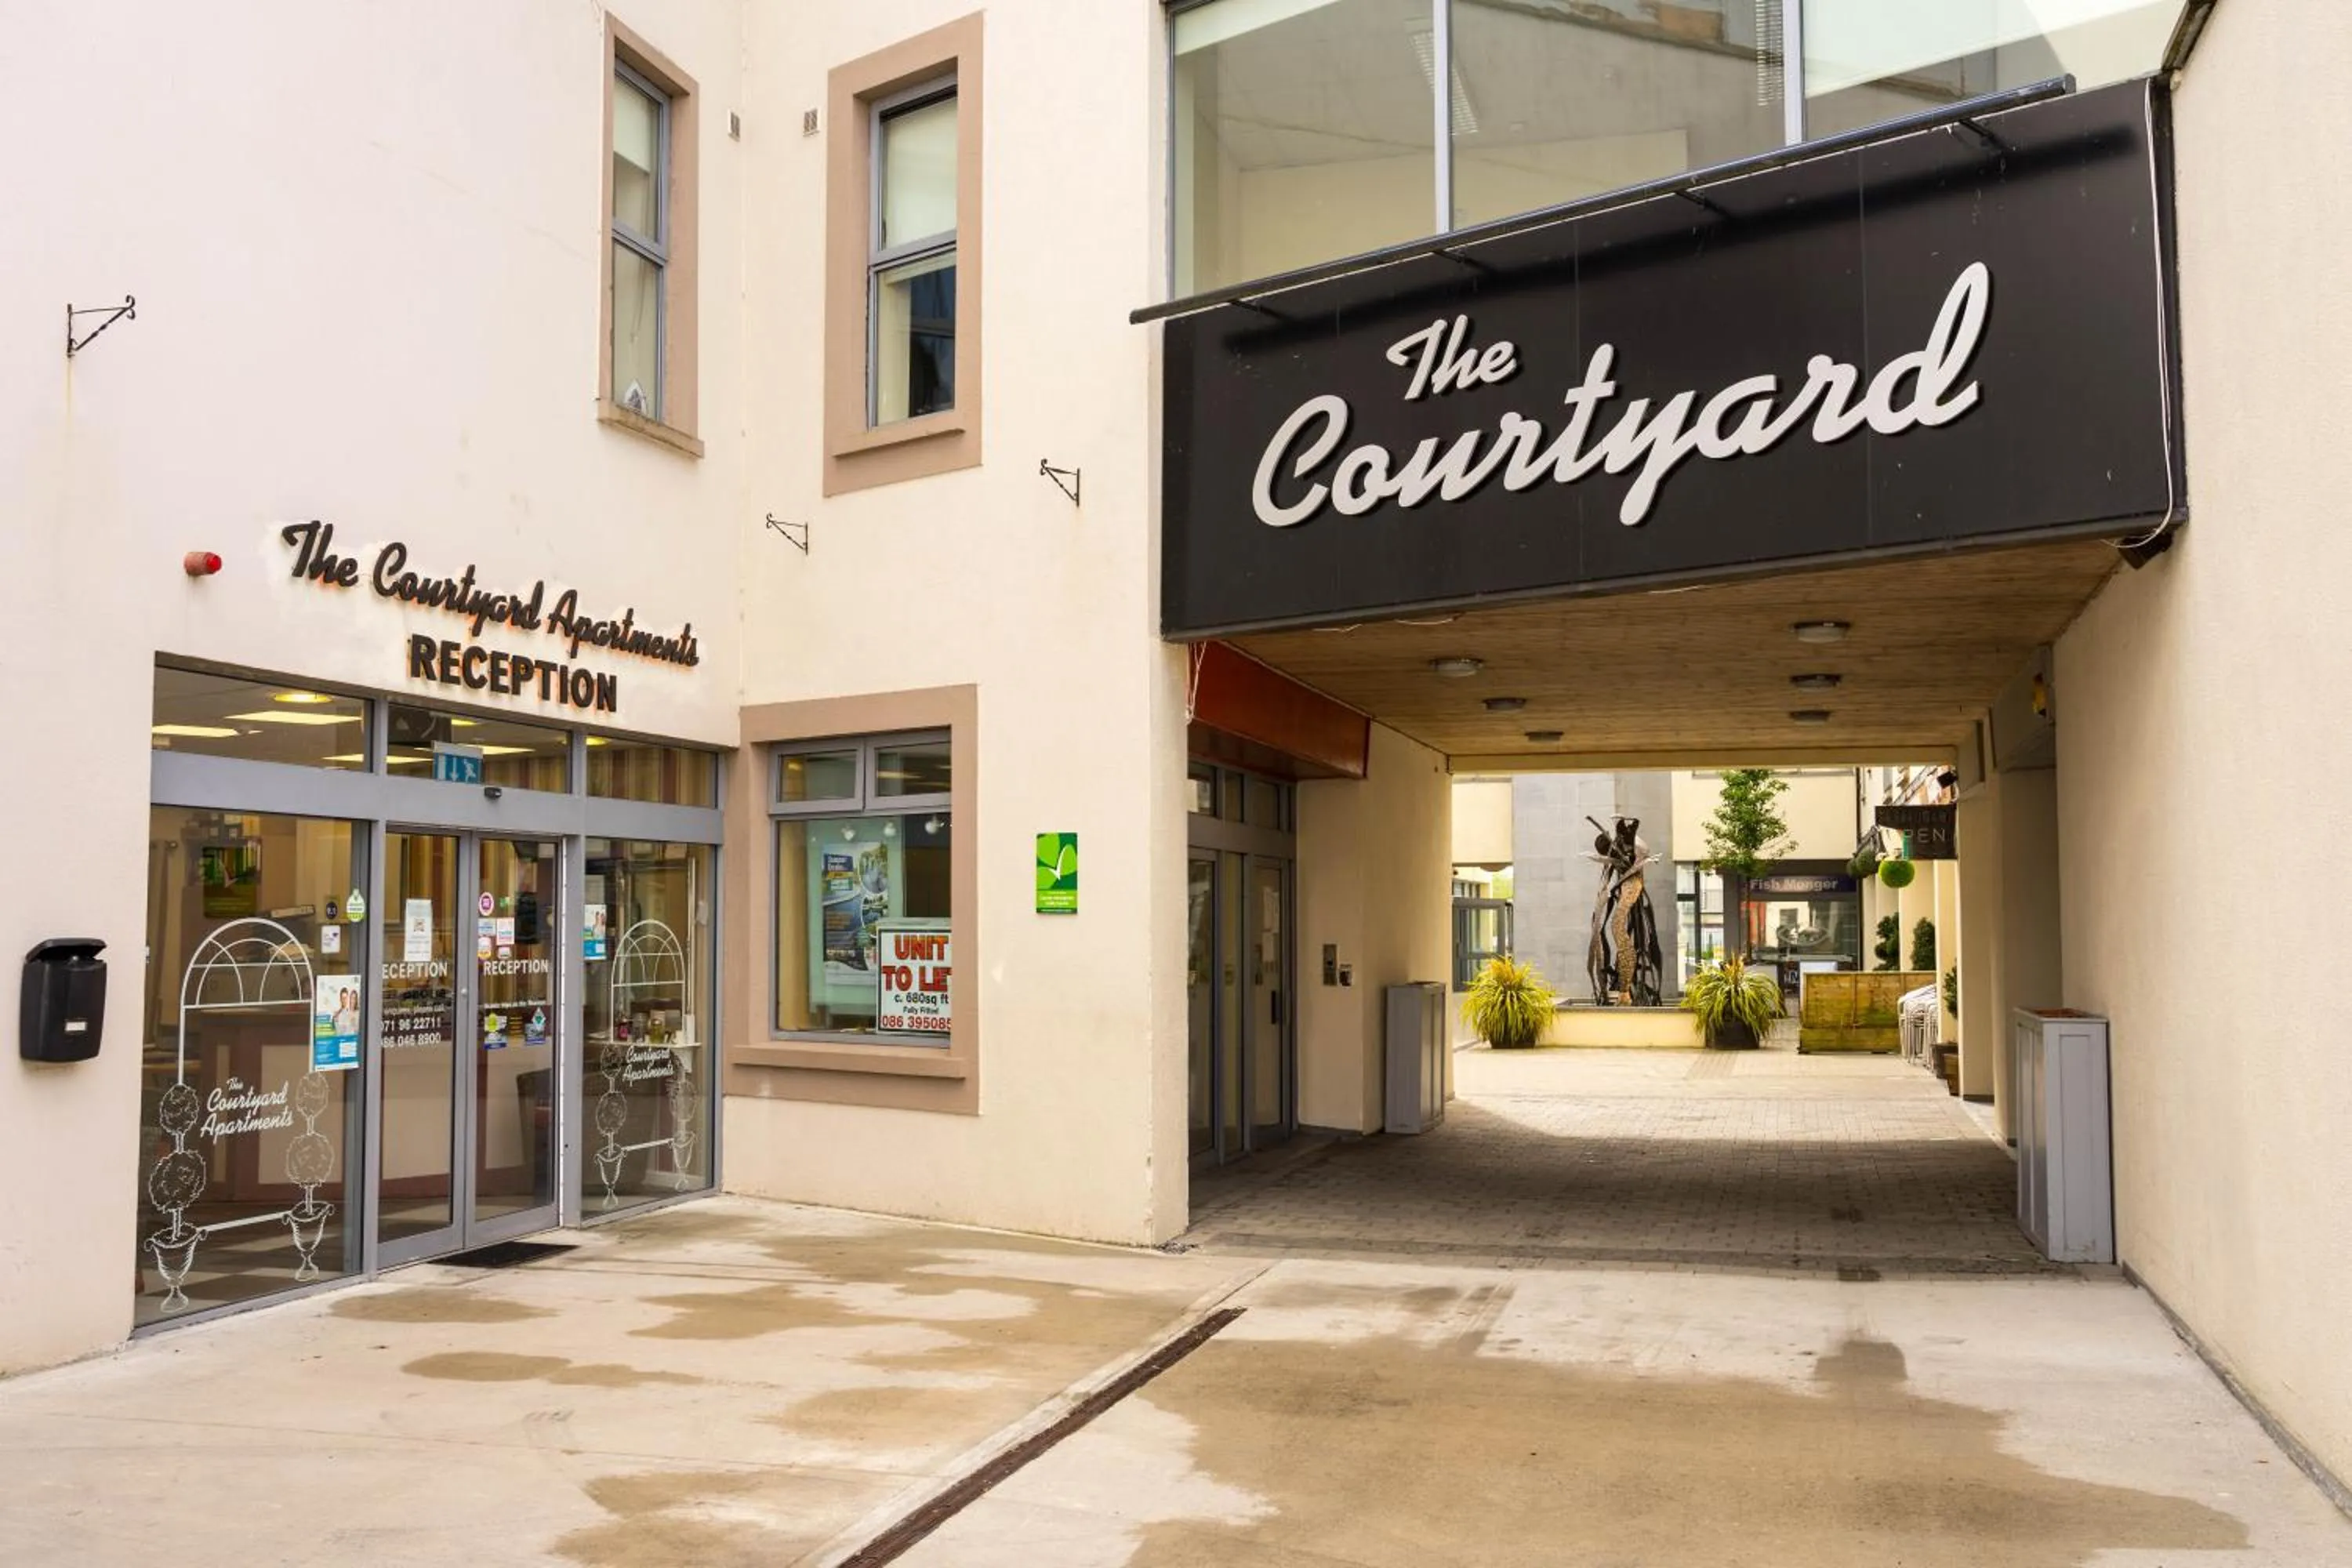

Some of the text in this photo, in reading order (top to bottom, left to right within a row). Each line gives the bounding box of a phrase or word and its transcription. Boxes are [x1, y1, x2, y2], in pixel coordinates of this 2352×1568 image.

[1385, 314, 1518, 400] The
[1252, 261, 1991, 527] Courtyard
[281, 520, 700, 666] The Courtyard Apartments
[408, 633, 619, 713] RECEPTION
[1903, 828, 1945, 843] PEN
[1749, 877, 1839, 891] Fish Monger
[895, 934, 949, 961] UNIT
[382, 961, 448, 979] ECEPTION
[484, 959, 549, 975] RECEPTION
[881, 965, 913, 992] TO
[906, 992, 938, 1006] 680sq
[881, 1014, 904, 1028] 086
[226, 1076, 245, 1091] The
[206, 1080, 289, 1116] Courtyard
[200, 1105, 295, 1146] Apartments
